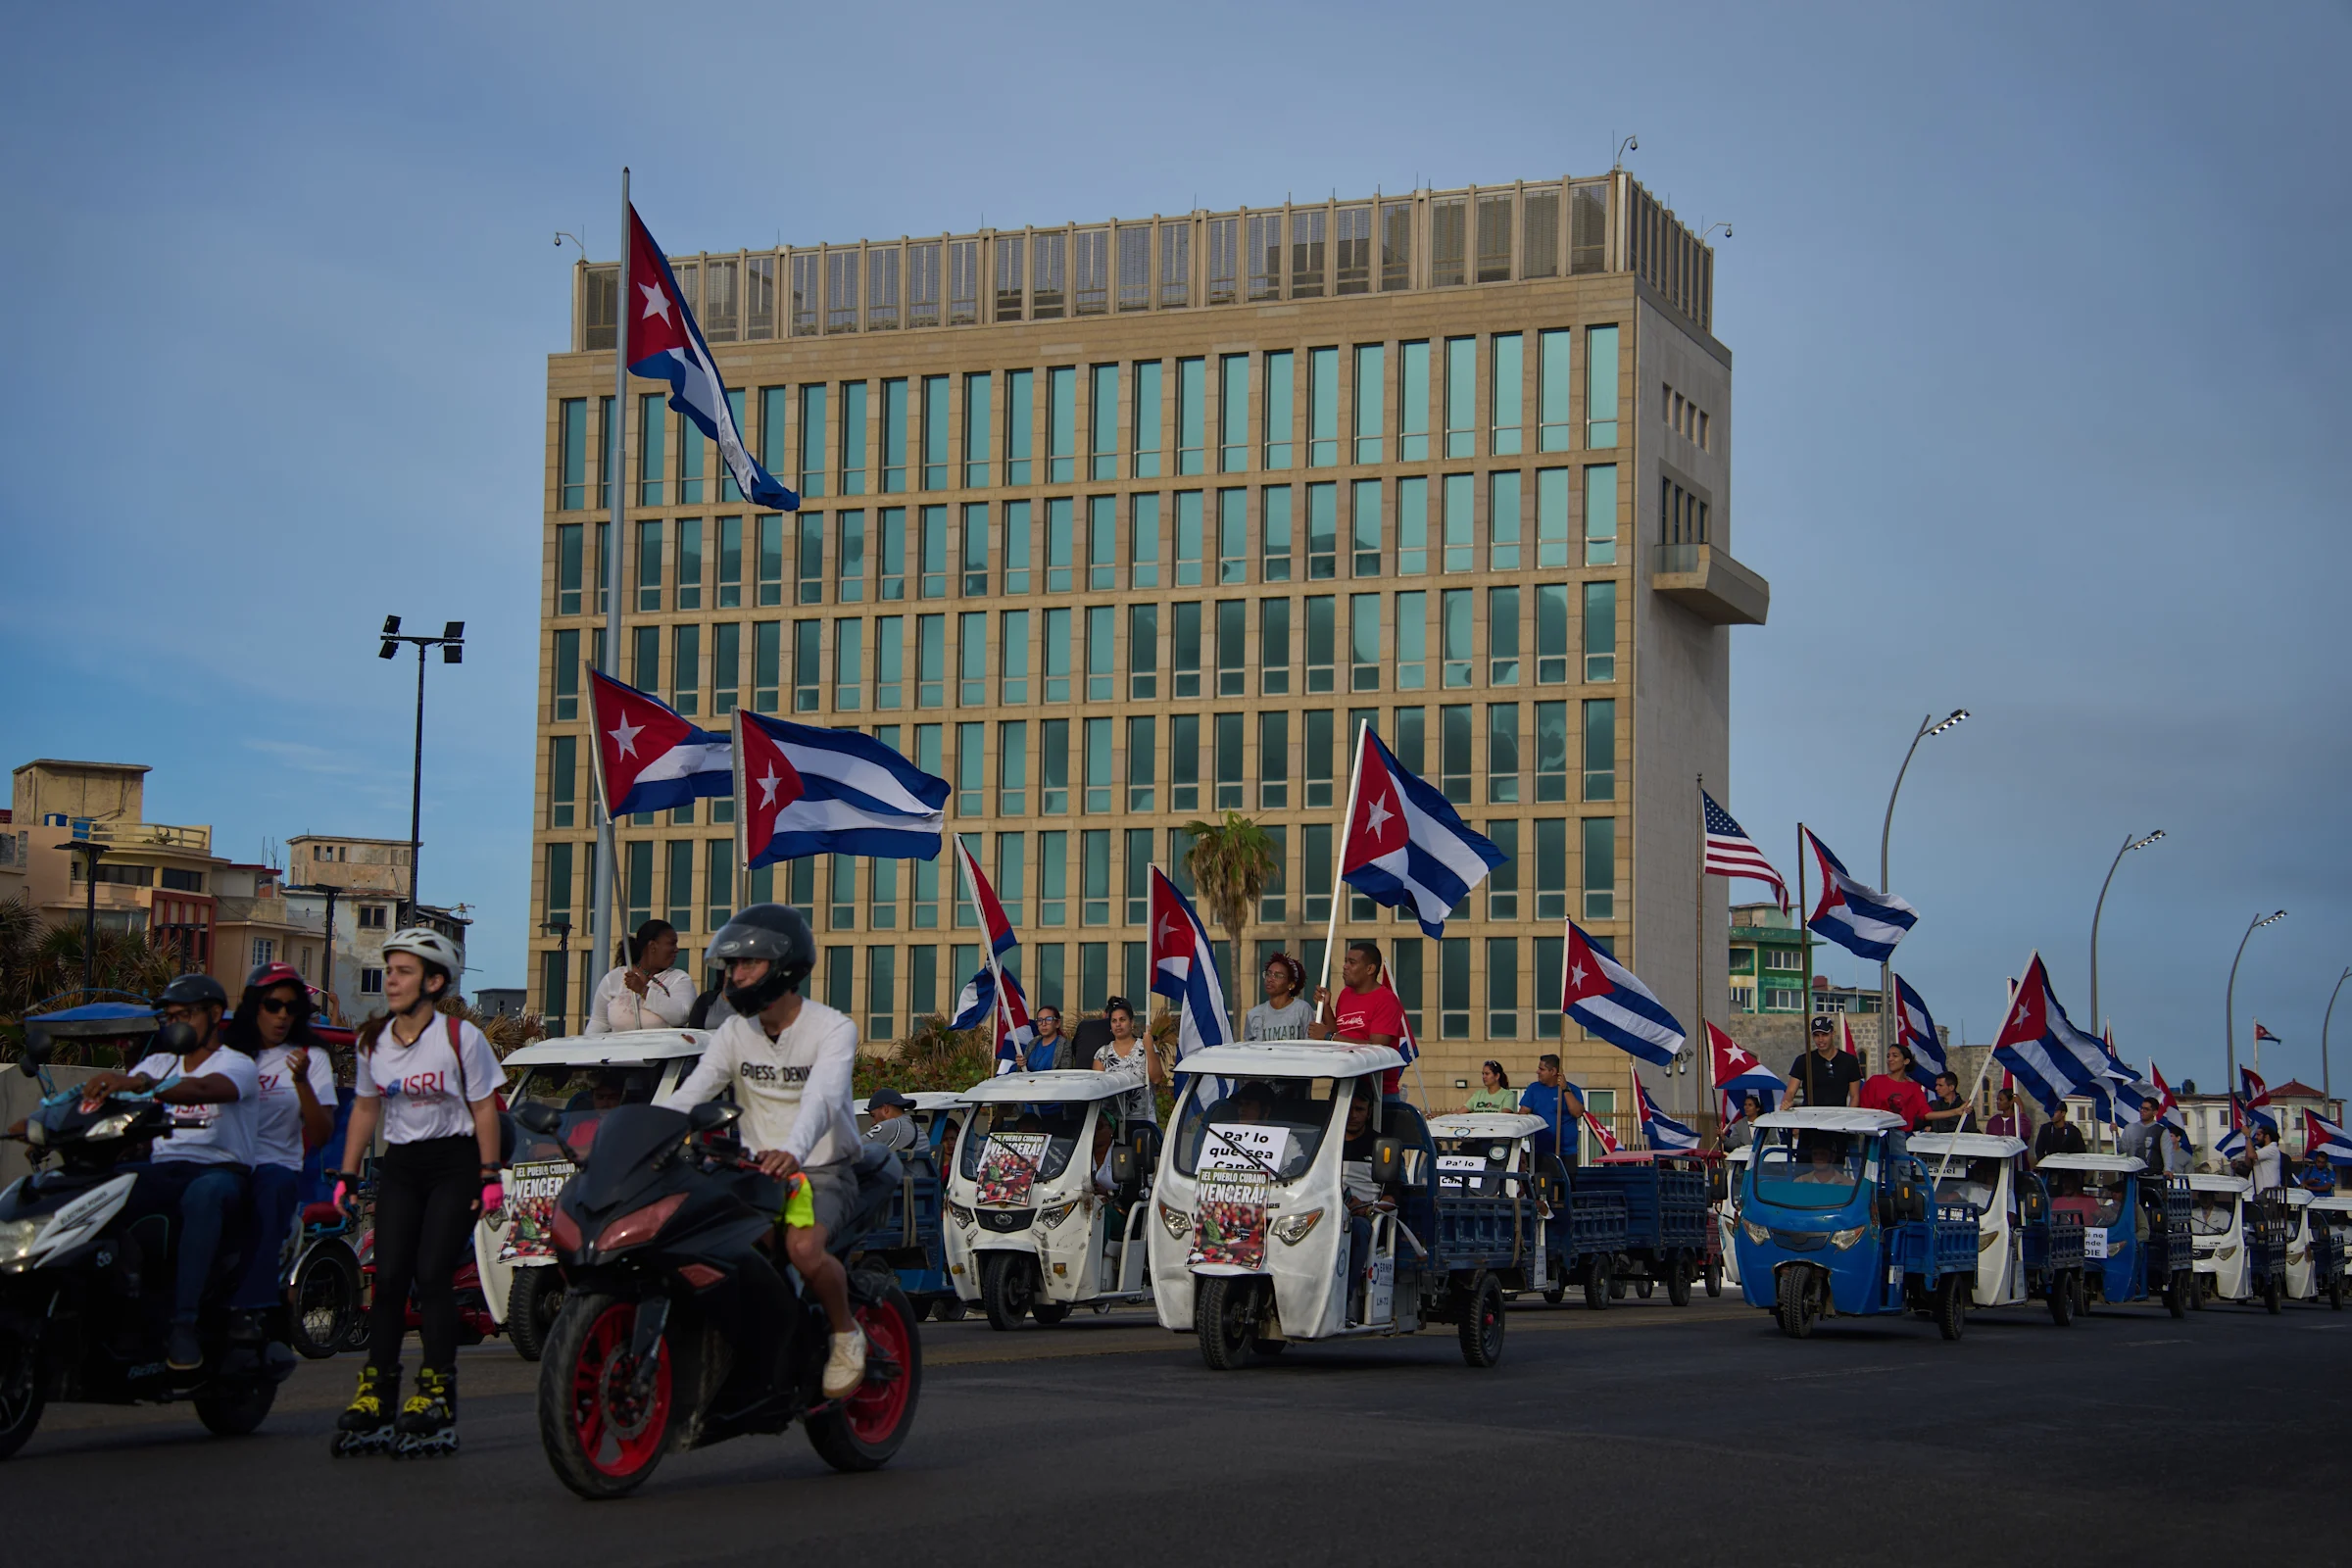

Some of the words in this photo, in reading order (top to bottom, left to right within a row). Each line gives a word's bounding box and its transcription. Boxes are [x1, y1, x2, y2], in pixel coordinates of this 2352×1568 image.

[741, 1061, 775, 1080] GUESS
[258, 1075, 278, 1090] RI
[404, 1070, 445, 1097] ISRI
[1253, 1132, 1269, 1144] lo
[1209, 1147, 1240, 1158] que
[1246, 1150, 1274, 1159] sea
[515, 1166, 525, 1177] ¡EL
[526, 1164, 549, 1177] PUEBLO
[549, 1162, 576, 1175] CUBANO
[1201, 1171, 1211, 1181] ¡EL
[1212, 1171, 1238, 1182] PUEBLO
[1239, 1173, 1266, 1184] CUBANO
[1200, 1183, 1265, 1204] VENCERÁ!
